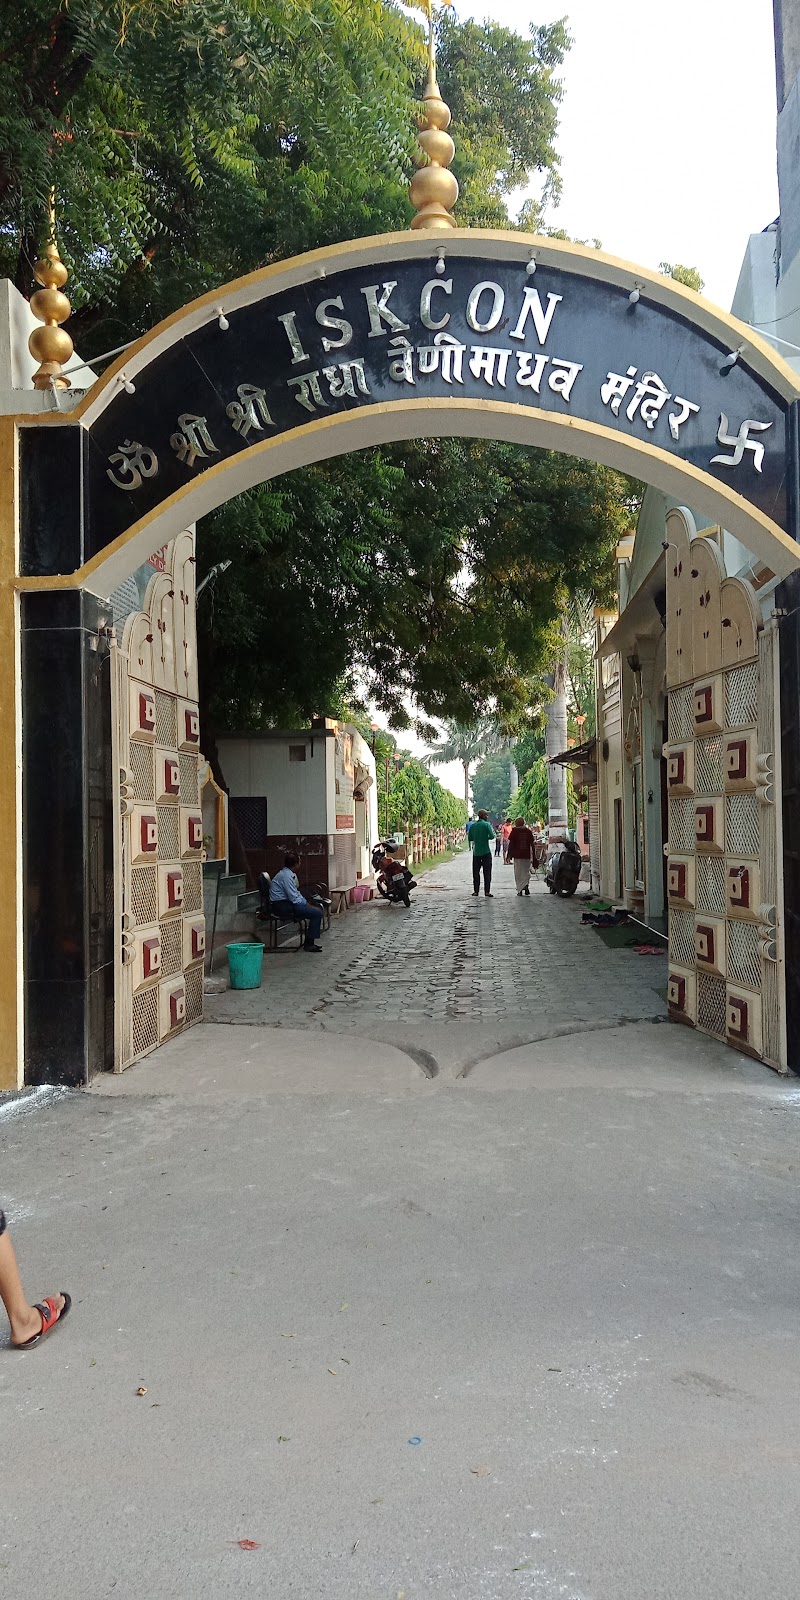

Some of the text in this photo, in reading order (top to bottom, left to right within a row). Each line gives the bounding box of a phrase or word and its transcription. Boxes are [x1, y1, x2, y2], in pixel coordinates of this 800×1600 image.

[277, 278, 563, 364] ISKCON
[169, 413, 220, 467] श्री
[226, 383, 277, 437] श्री
[286, 357, 371, 412] राधा
[387, 331, 584, 402] वेणीमाधव
[601, 365, 700, 441] मंदिर
